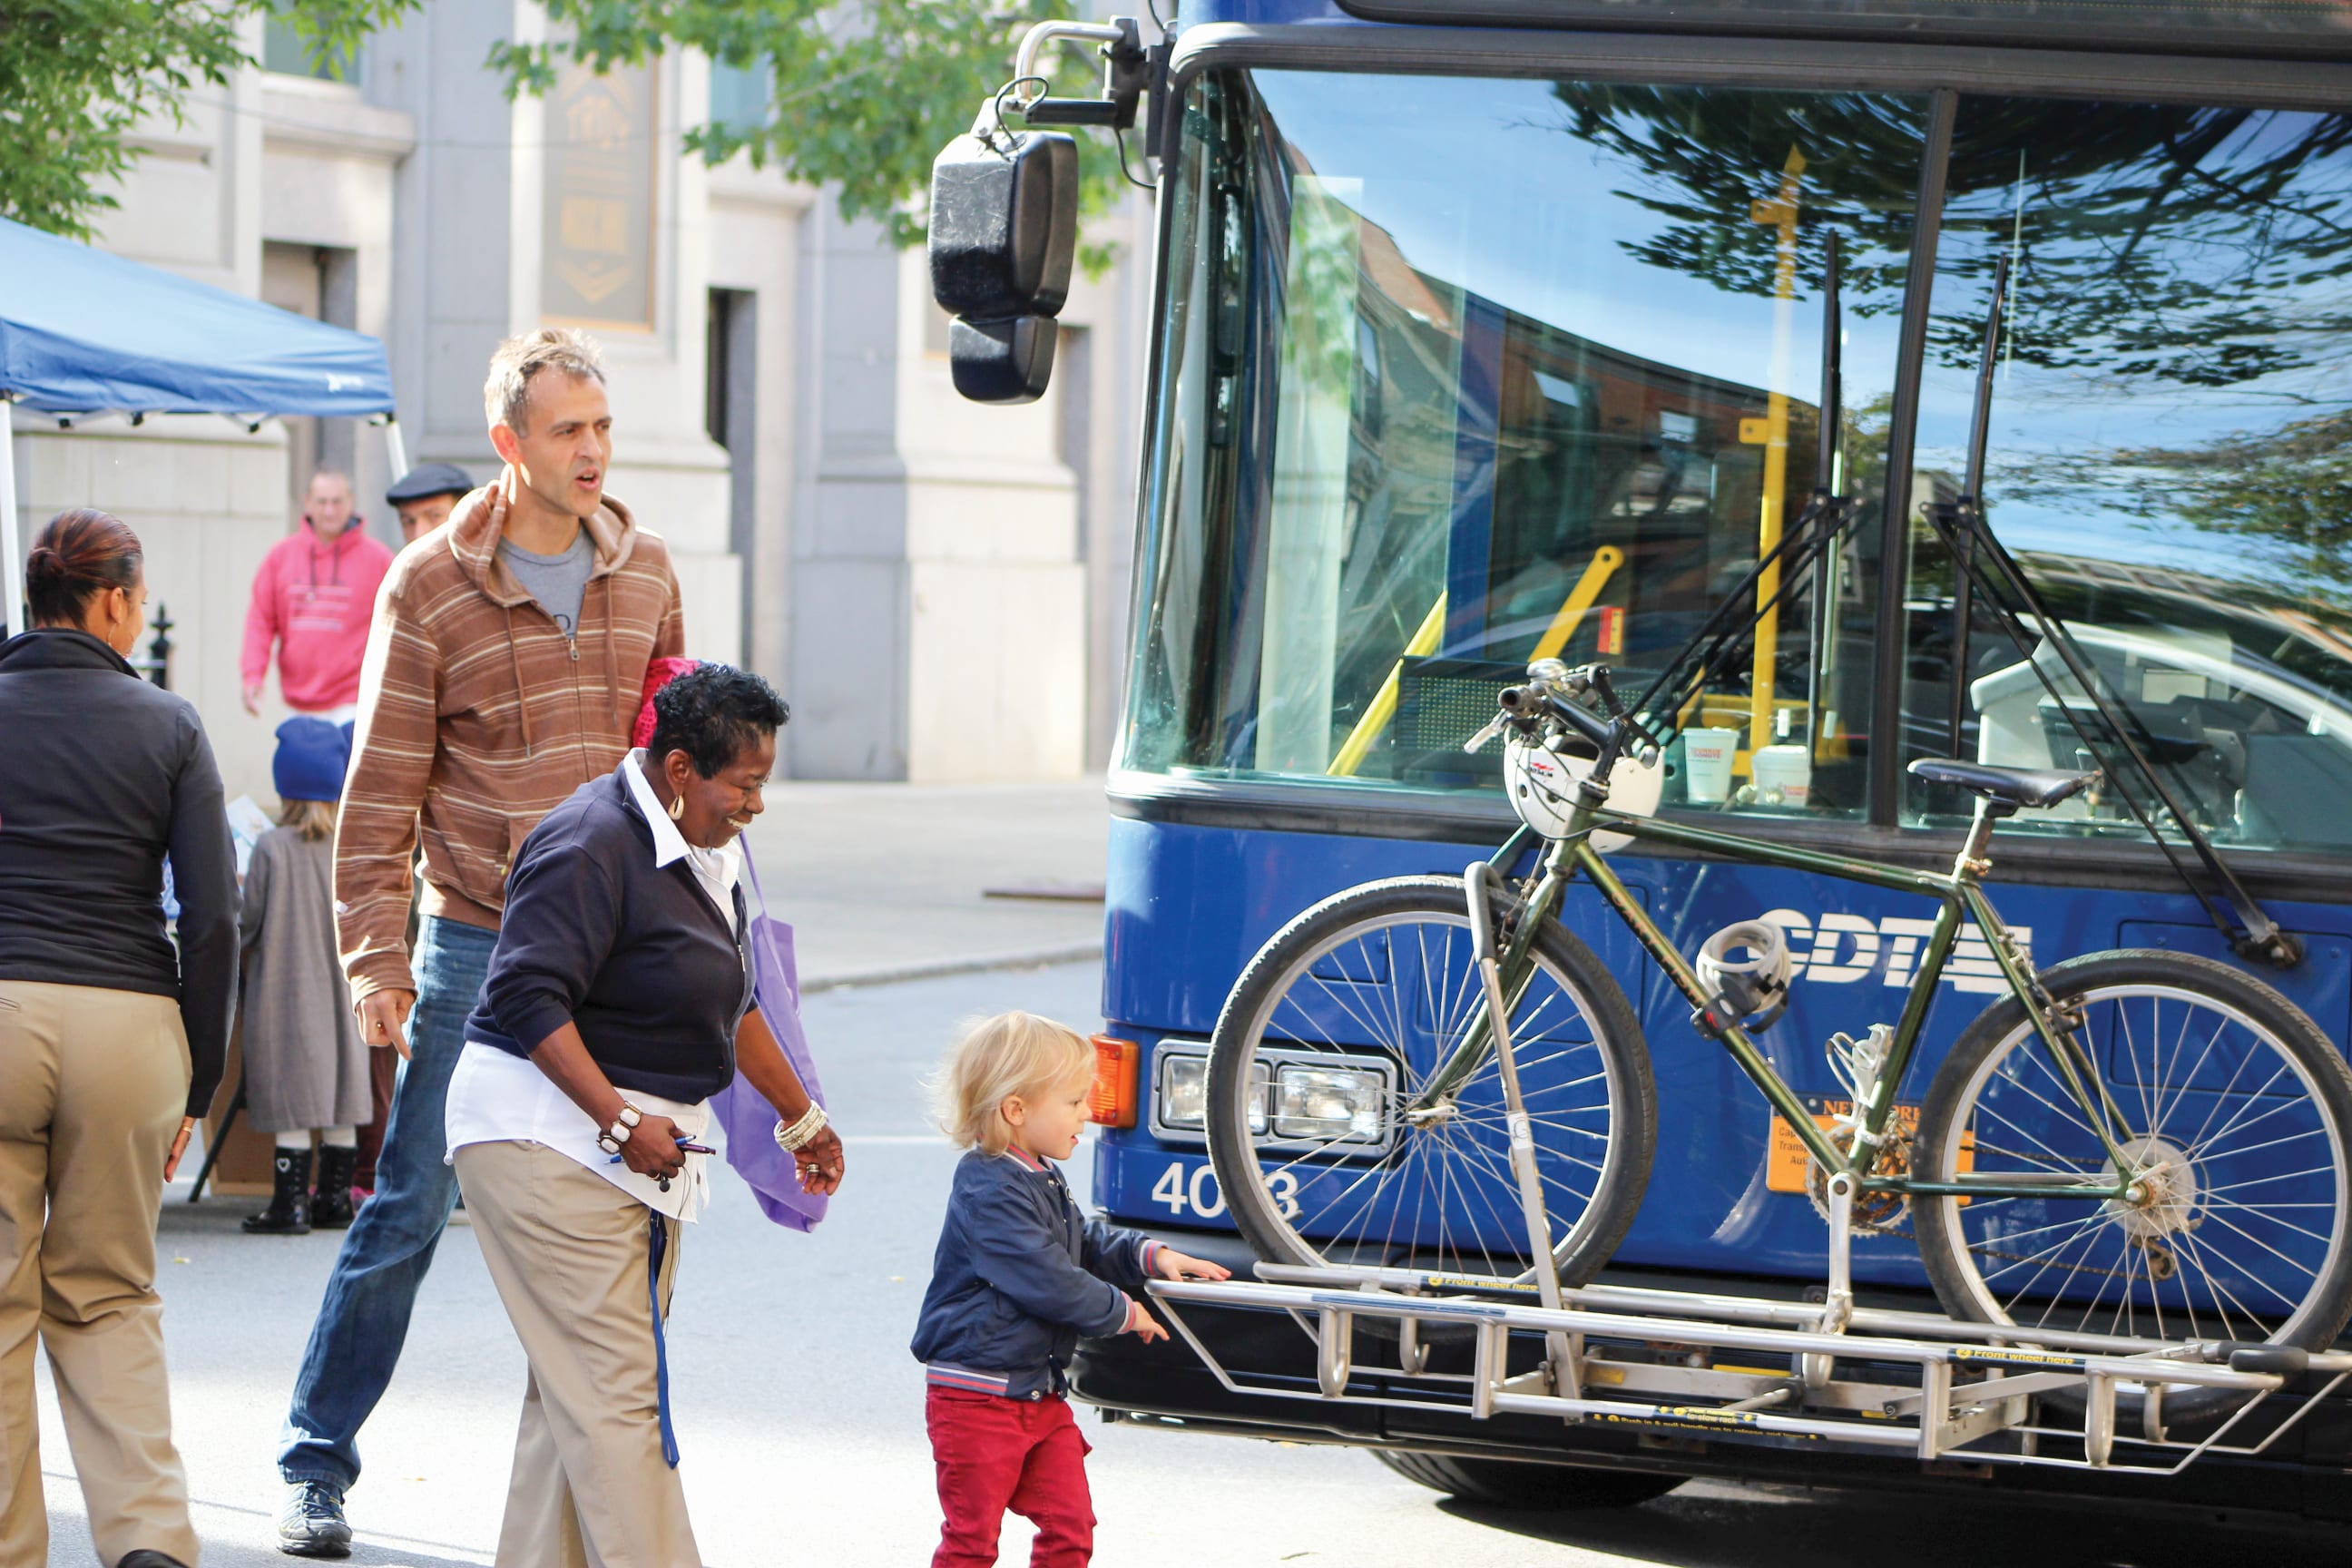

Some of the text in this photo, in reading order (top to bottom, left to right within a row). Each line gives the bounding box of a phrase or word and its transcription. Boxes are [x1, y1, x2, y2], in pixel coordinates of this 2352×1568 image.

[1611, 890, 1704, 1004] GARY FISH
[1748, 908, 2032, 995] CDTA
[1823, 1100, 1854, 1115] NE
[1152, 1161, 1299, 1221] 403
[1974, 1349, 2007, 1360] Front
[2008, 1352, 2044, 1363] wheel
[2045, 1356, 2074, 1366] here
